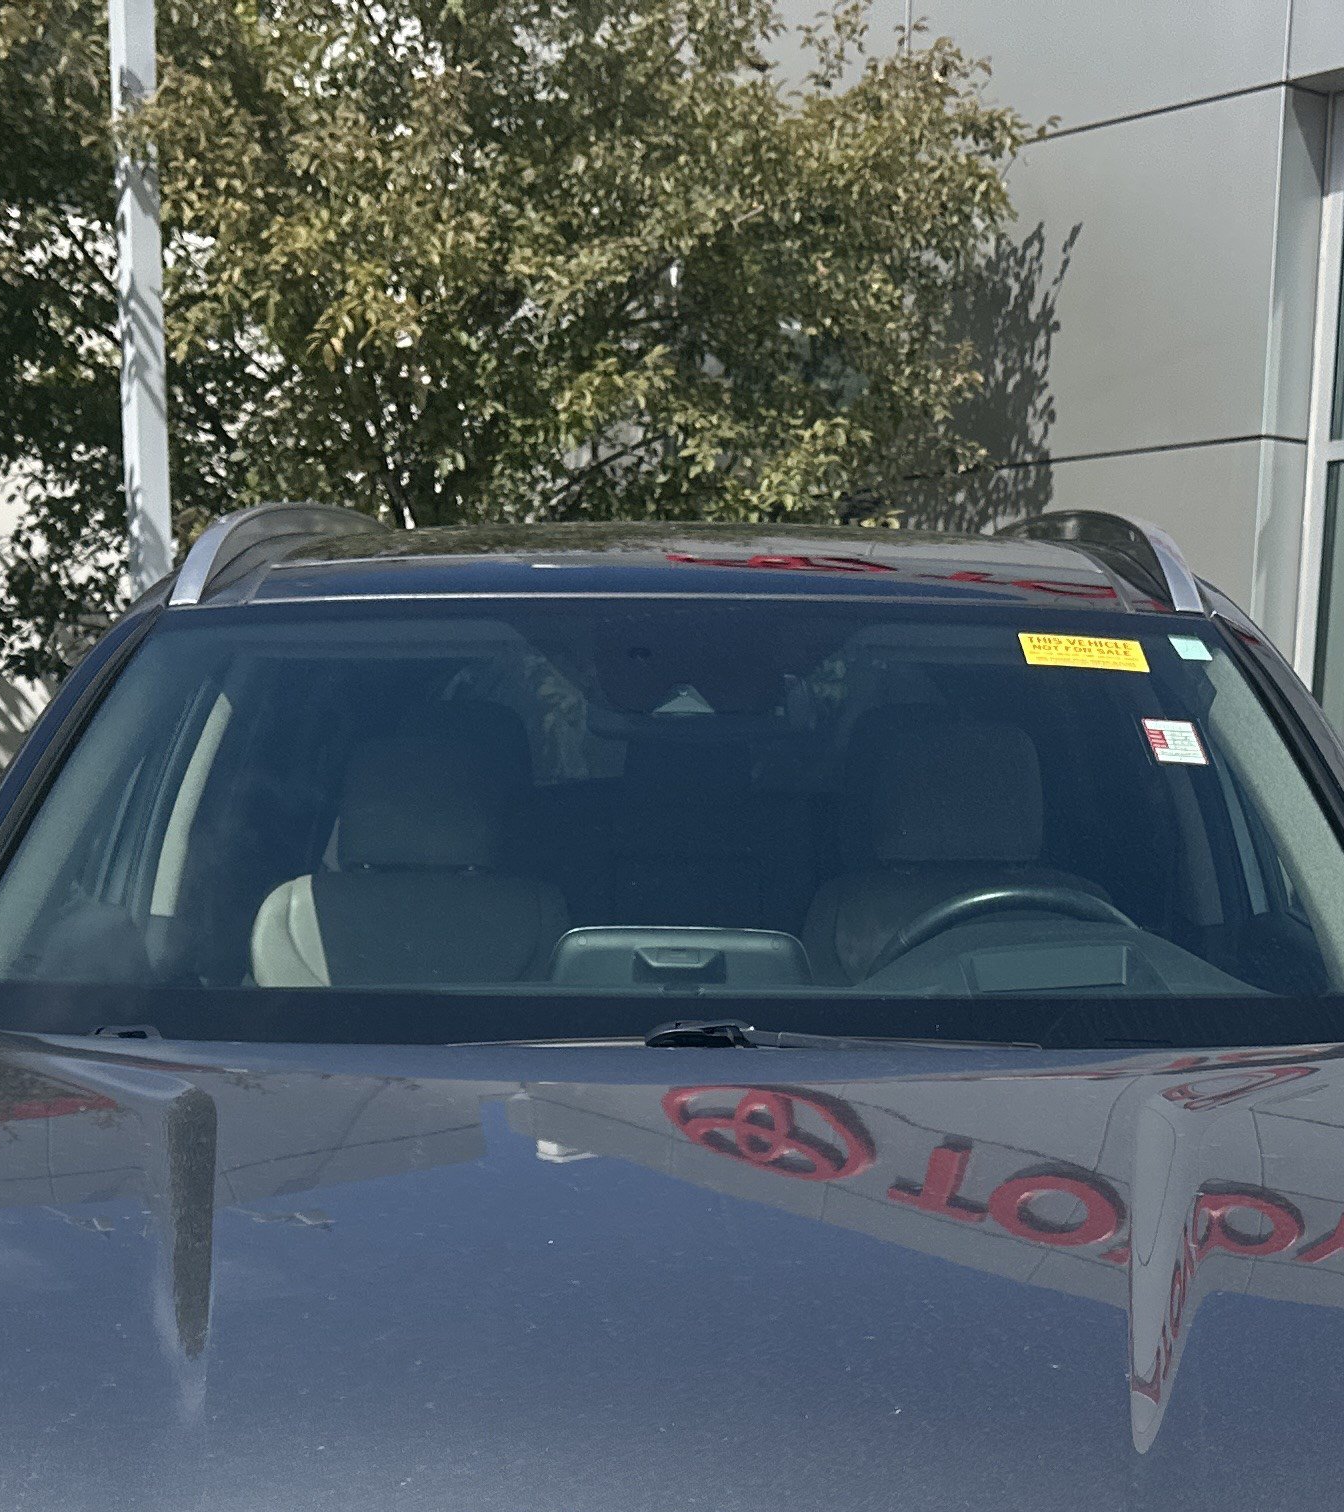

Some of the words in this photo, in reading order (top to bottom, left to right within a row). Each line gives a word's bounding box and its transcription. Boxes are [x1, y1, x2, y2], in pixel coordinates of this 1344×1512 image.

[1027, 636, 1062, 645] THIS
[1066, 638, 1132, 650] VEHICLE
[1097, 648, 1131, 656] SALE
